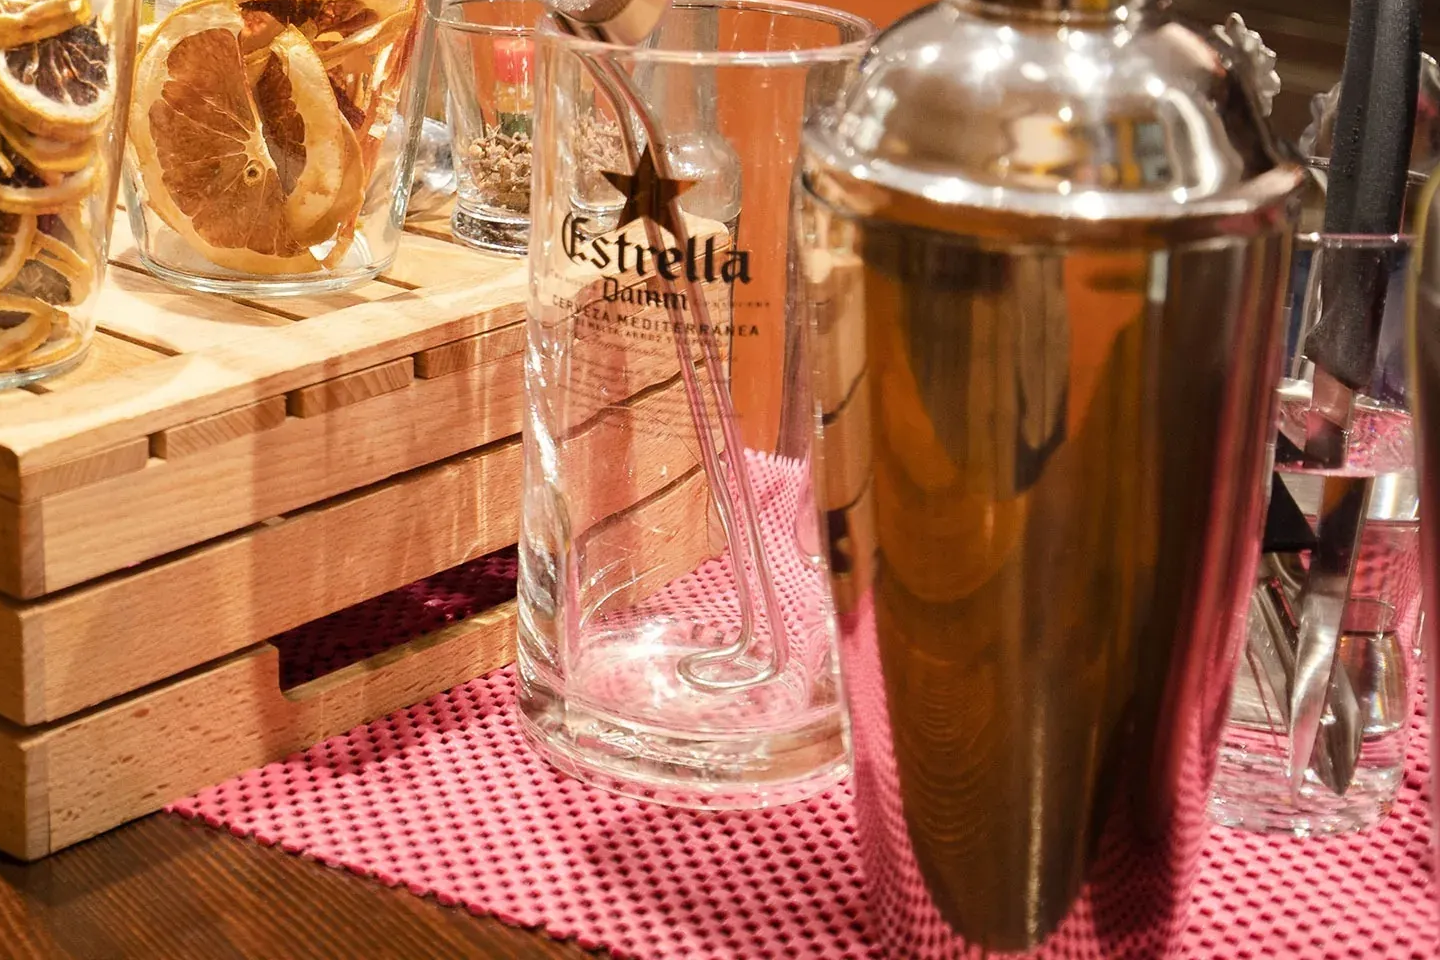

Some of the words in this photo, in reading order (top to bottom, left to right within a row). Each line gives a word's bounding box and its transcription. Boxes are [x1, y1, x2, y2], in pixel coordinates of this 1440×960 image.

[562, 212, 751, 284] Estrella
[553, 294, 611, 322] CERVEZA
[602, 275, 686, 311] Damm
